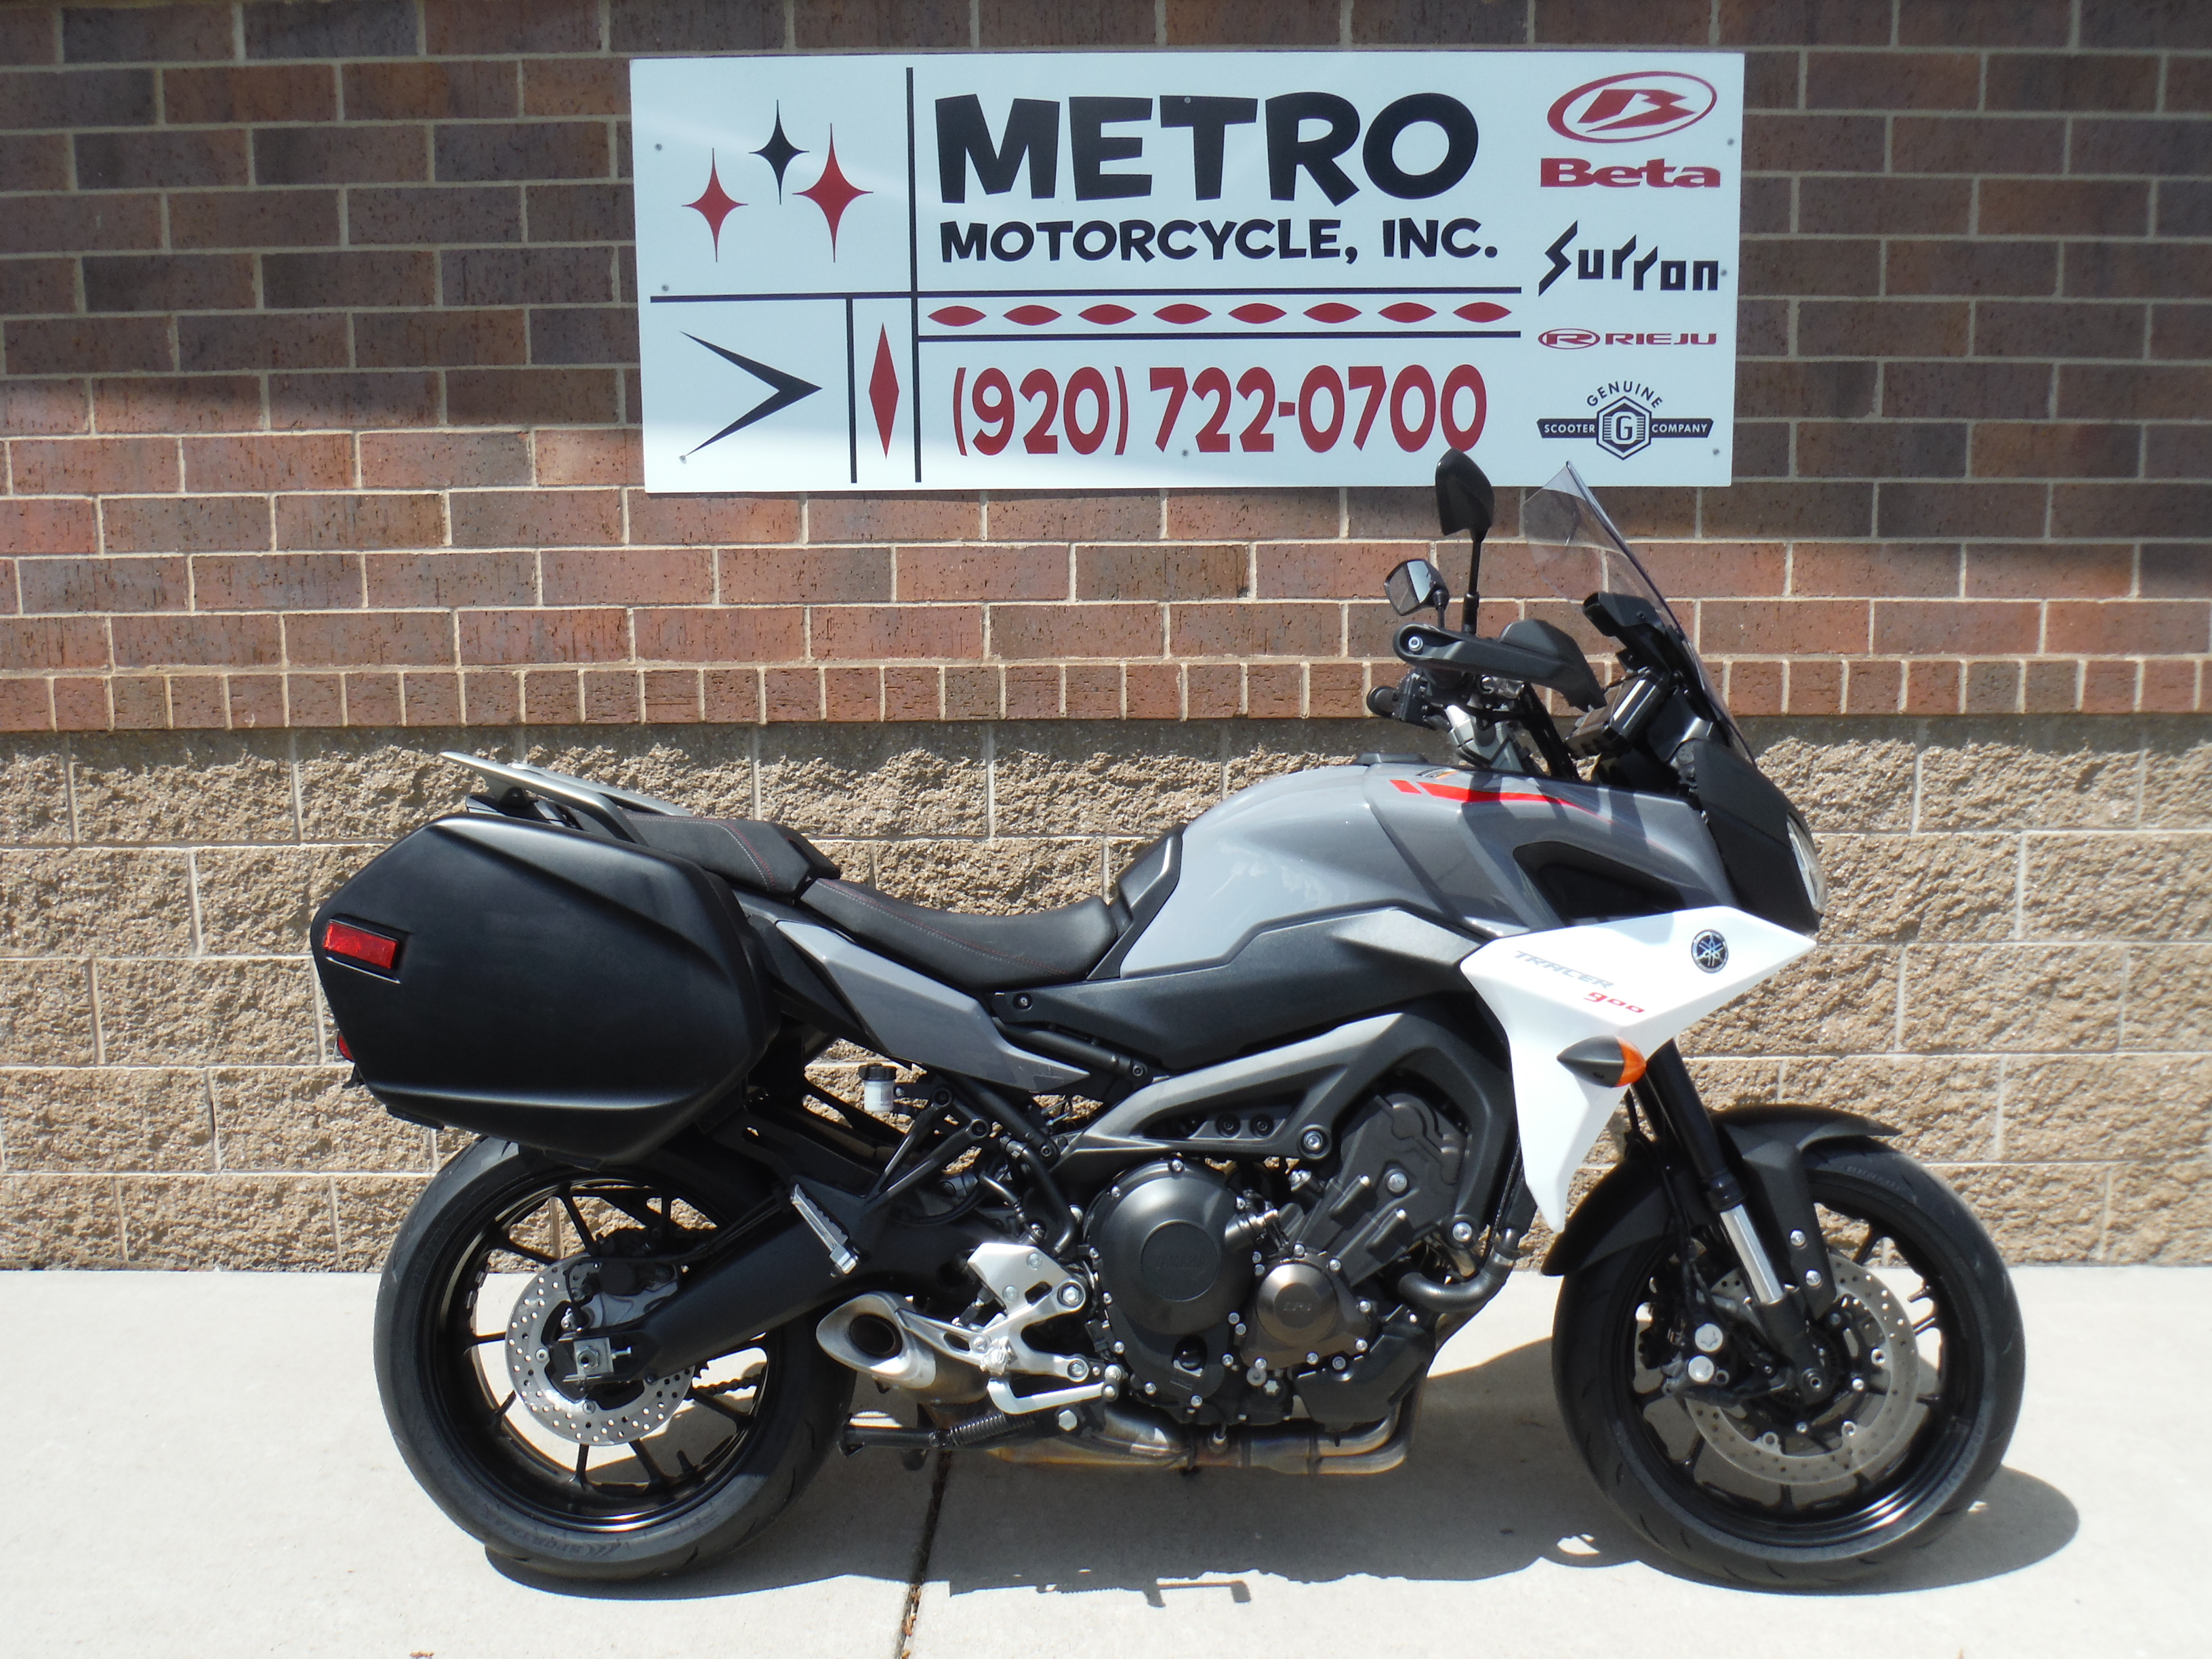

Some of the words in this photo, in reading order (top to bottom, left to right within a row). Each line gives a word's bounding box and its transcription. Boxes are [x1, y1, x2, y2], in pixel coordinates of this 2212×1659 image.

[935, 91, 1479, 207] METRO
[1540, 157, 1721, 188] Beta
[939, 218, 1358, 264] MOTORCYCLE,
[1382, 217, 1498, 259] INC.
[1538, 220, 1719, 297] Surron
[1605, 333, 1717, 345] RIEJU
[953, 366, 1129, 456] (920)
[1149, 364, 1488, 453] 722-0700
[1586, 380, 1663, 408] GENUINE
[1544, 424, 1596, 434] SCOOTER
[1616, 415, 1633, 441] G
[1651, 424, 1708, 434] COMPANY
[1514, 950, 1615, 989] TRACER
[1583, 991, 1646, 1014] 900
